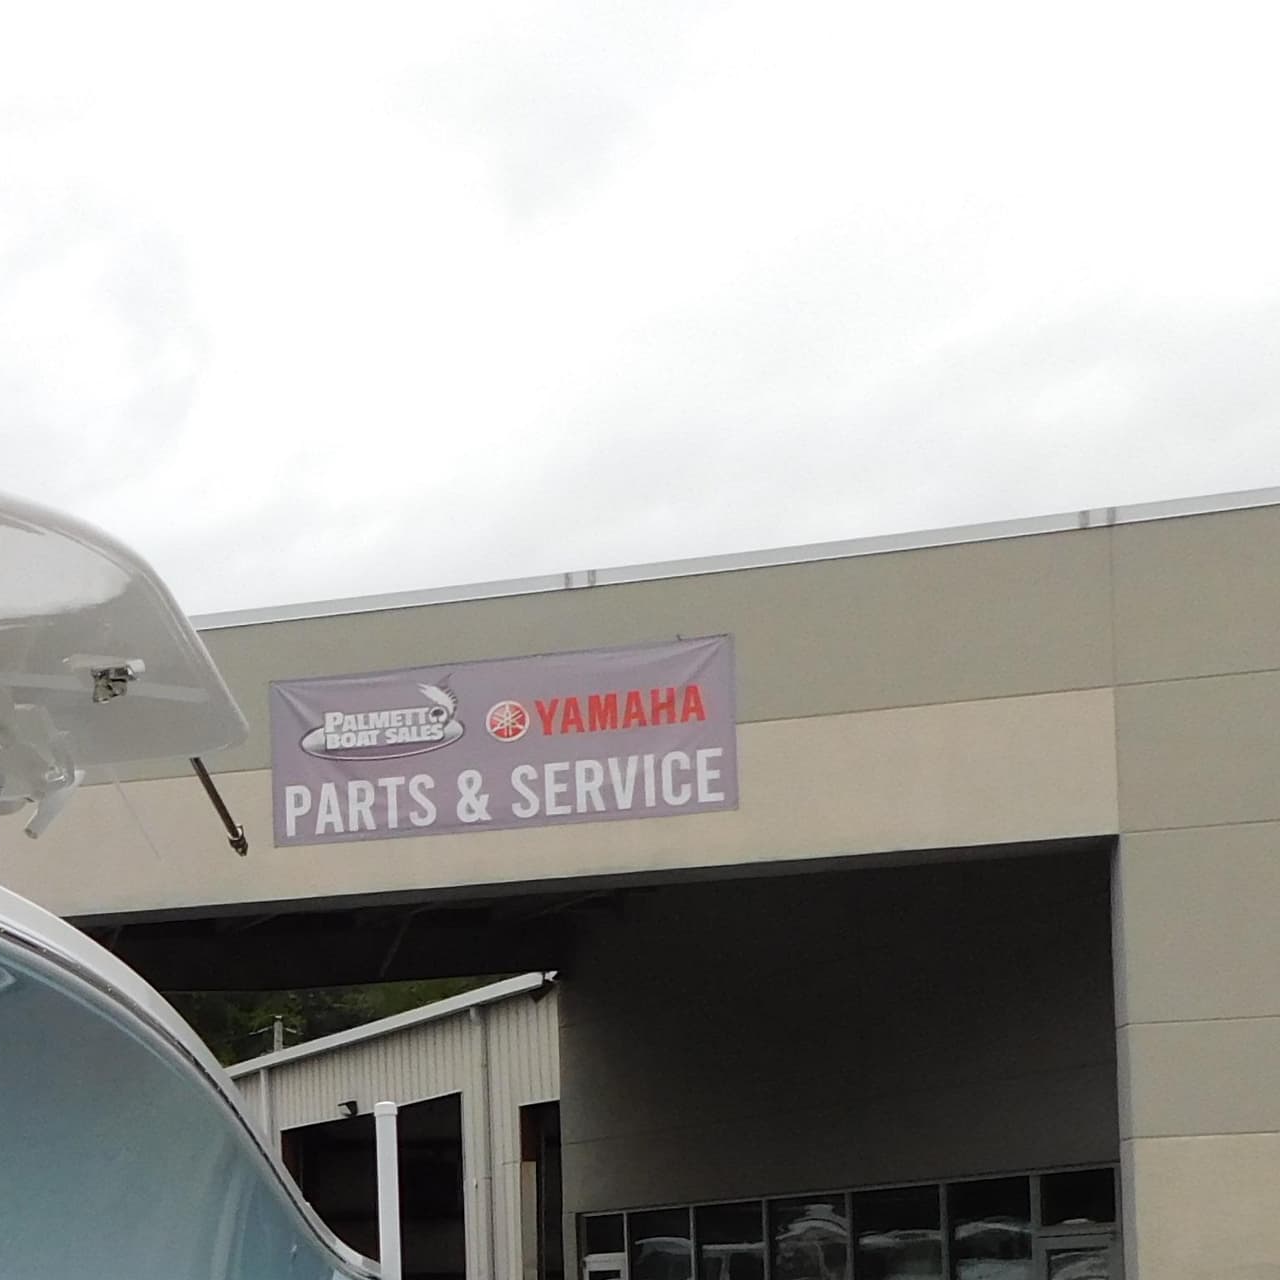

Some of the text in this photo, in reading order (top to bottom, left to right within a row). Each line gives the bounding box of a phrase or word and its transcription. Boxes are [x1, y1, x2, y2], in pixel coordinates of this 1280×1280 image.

[324, 706, 448, 733] PALMETTO
[535, 684, 706, 735] YAMAHA
[326, 723, 443, 750] BOAT SALES
[285, 748, 724, 837] PARTS & SERVICE
